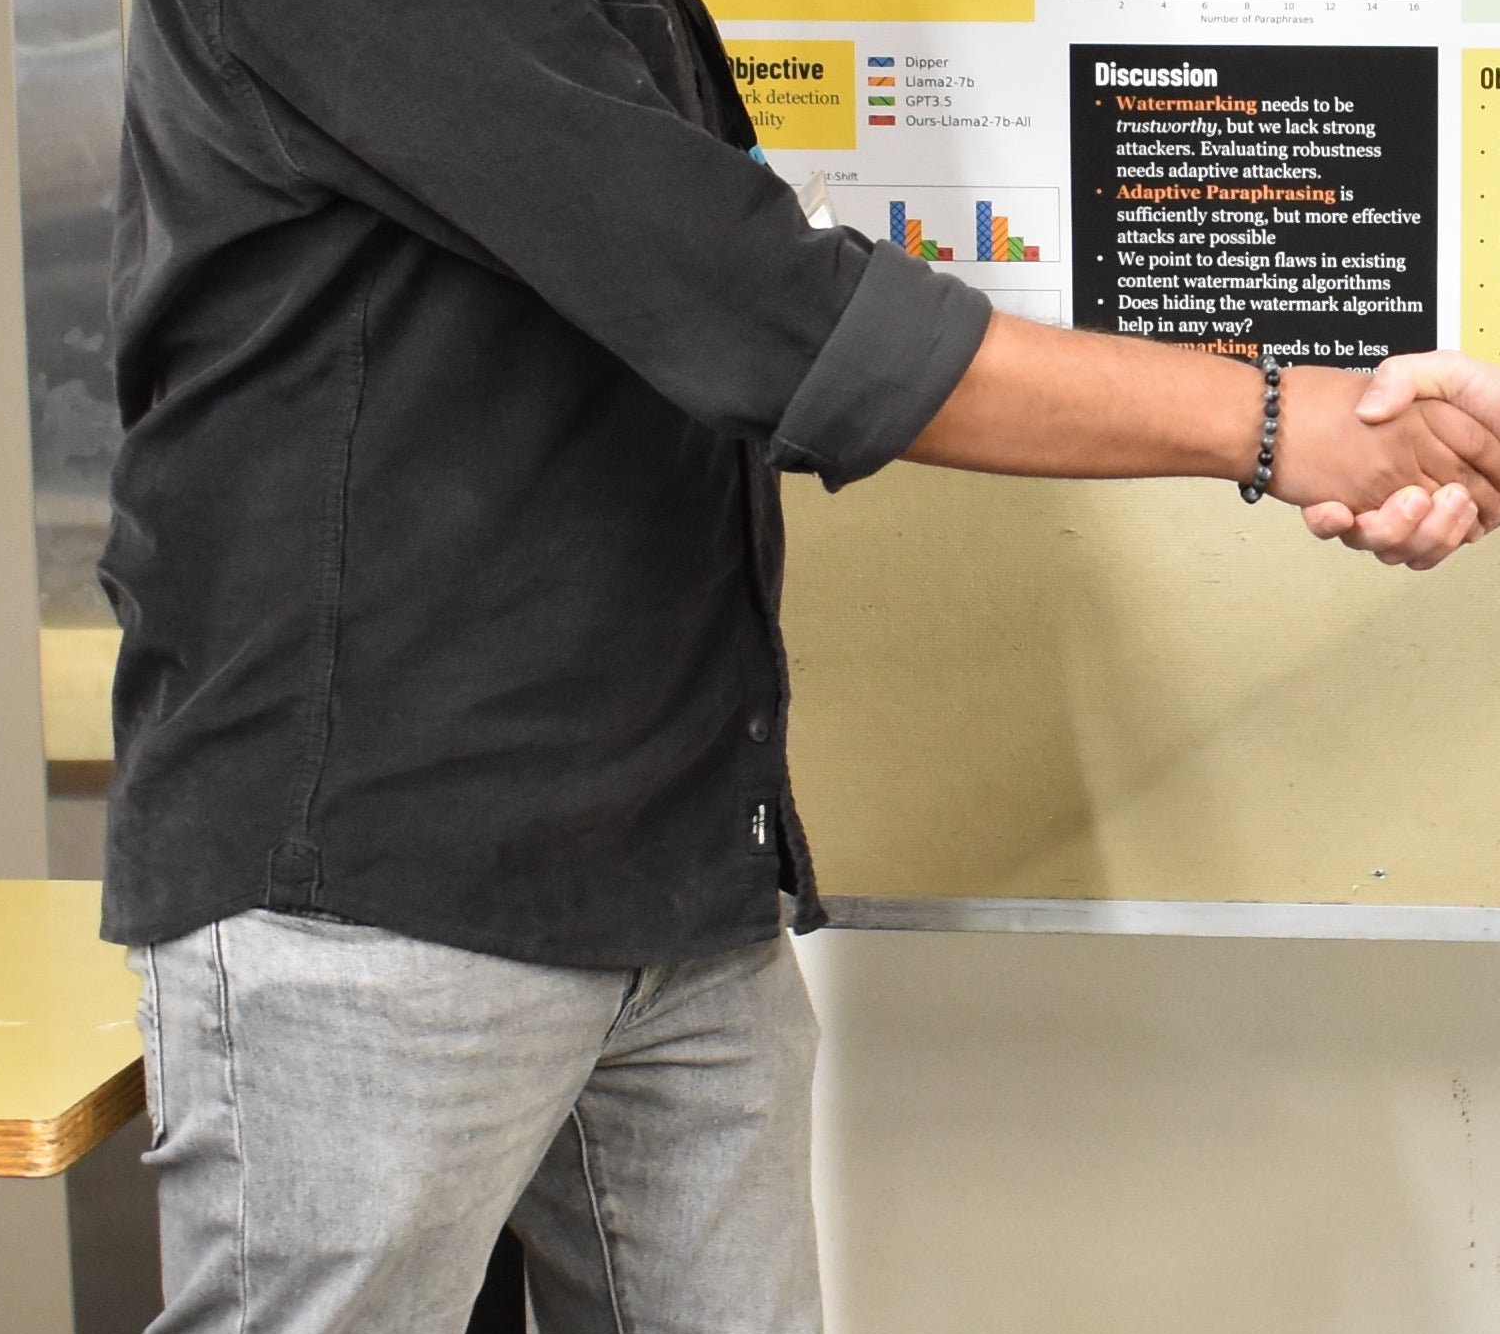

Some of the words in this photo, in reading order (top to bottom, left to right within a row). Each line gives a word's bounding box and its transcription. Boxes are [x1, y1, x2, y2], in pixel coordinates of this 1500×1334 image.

[1119, 1, 1124, 10] 2
[1161, 1, 1167, 10] 4
[1202, 1, 1208, 10] 6
[1244, 2, 1250, 10] 8
[1284, 2, 1295, 11] 10
[1326, 2, 1336, 11] 12
[1367, 2, 1378, 11] 14
[1409, 2, 1420, 11] 16
[1200, 14, 1239, 24] Number
[1242, 14, 1252, 24] of
[1254, 15, 1314, 25] Paraphrases
[905, 56, 949, 70] Dipper
[905, 75, 975, 88] Llama2-7b
[1095, 61, 1218, 88] Discussion
[905, 95, 952, 108] GPT3.5
[1115, 95, 1258, 116] Watermarking
[1261, 95, 1309, 113] needs
[1313, 98, 1331, 113] to
[1333, 96, 1355, 113] be
[905, 114, 1031, 128] Ours-Llama2-7b-All
[1116, 183, 1202, 204] Adaptive
[1206, 184, 1337, 205] Paraphrasing
[1340, 185, 1354, 202] is
[1118, 294, 1159, 310] Does
[1162, 293, 1217, 314] hiding
[1219, 294, 1246, 311] the
[1249, 295, 1340, 312] watermark
[1342, 295, 1424, 316] algorithm
[1118, 315, 1154, 336] help
[1157, 316, 1174, 333] in
[1178, 321, 1209, 336] any
[1211, 317, 1253, 337] way?
